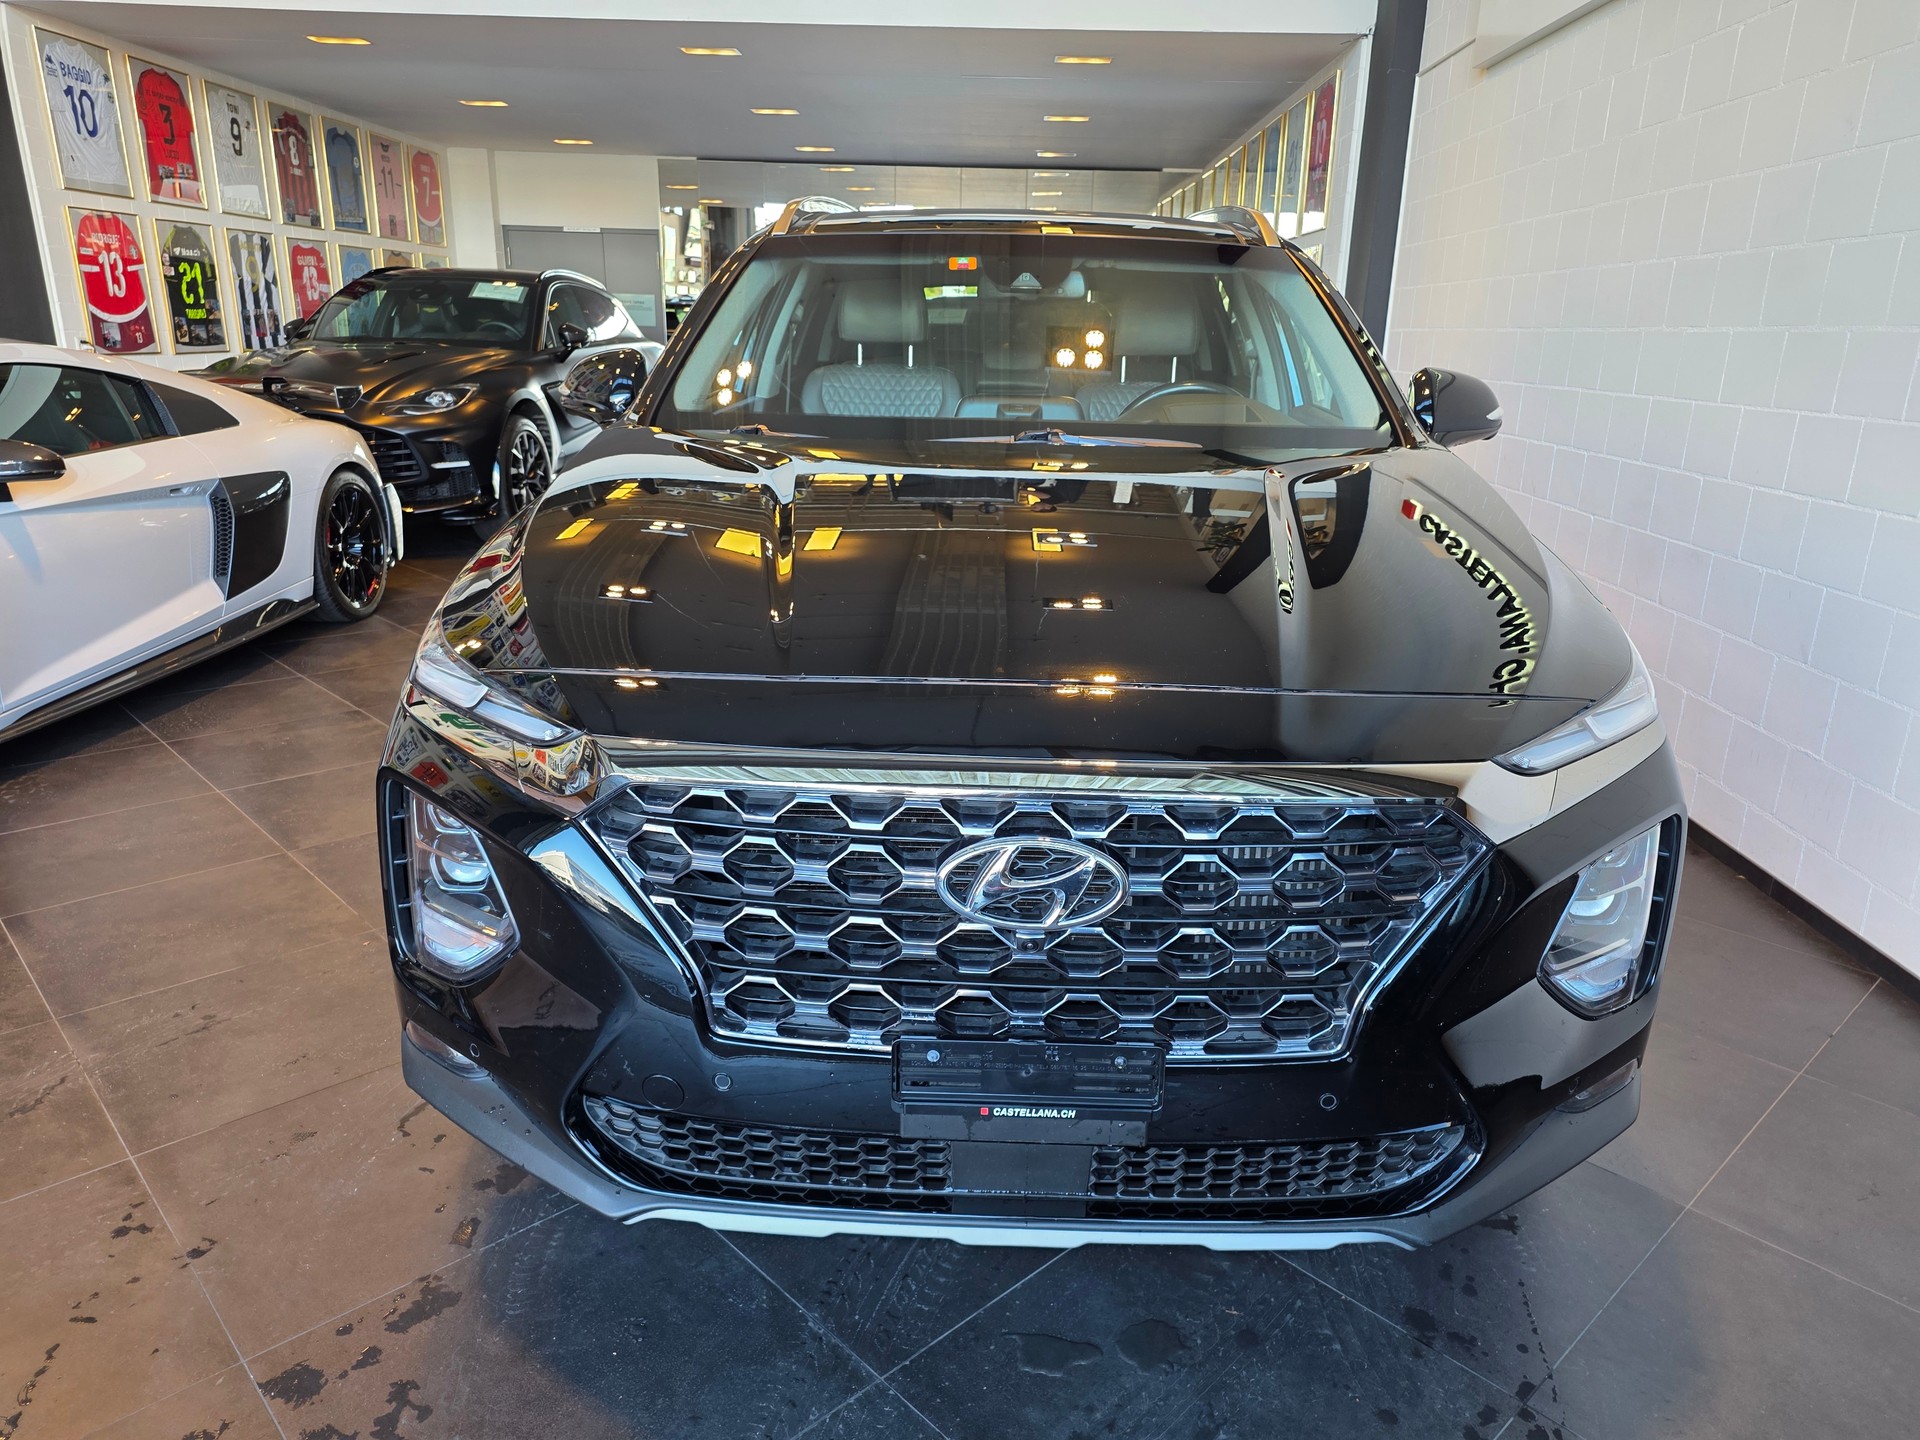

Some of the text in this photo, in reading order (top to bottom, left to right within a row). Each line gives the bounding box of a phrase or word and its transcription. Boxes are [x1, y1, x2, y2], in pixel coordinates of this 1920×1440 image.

[59, 61, 92, 85] BAGGIO
[63, 85, 99, 137] 10
[158, 103, 175, 145] 3
[230, 117, 243, 156] 9
[288, 135, 300, 166] 8
[381, 166, 396, 199] 11
[98, 250, 126, 298] 13
[178, 261, 205, 305] 21
[246, 255, 260, 293] 9
[302, 266, 320, 301] 13
[993, 1107, 1076, 1119] CASTELLANA.CH
